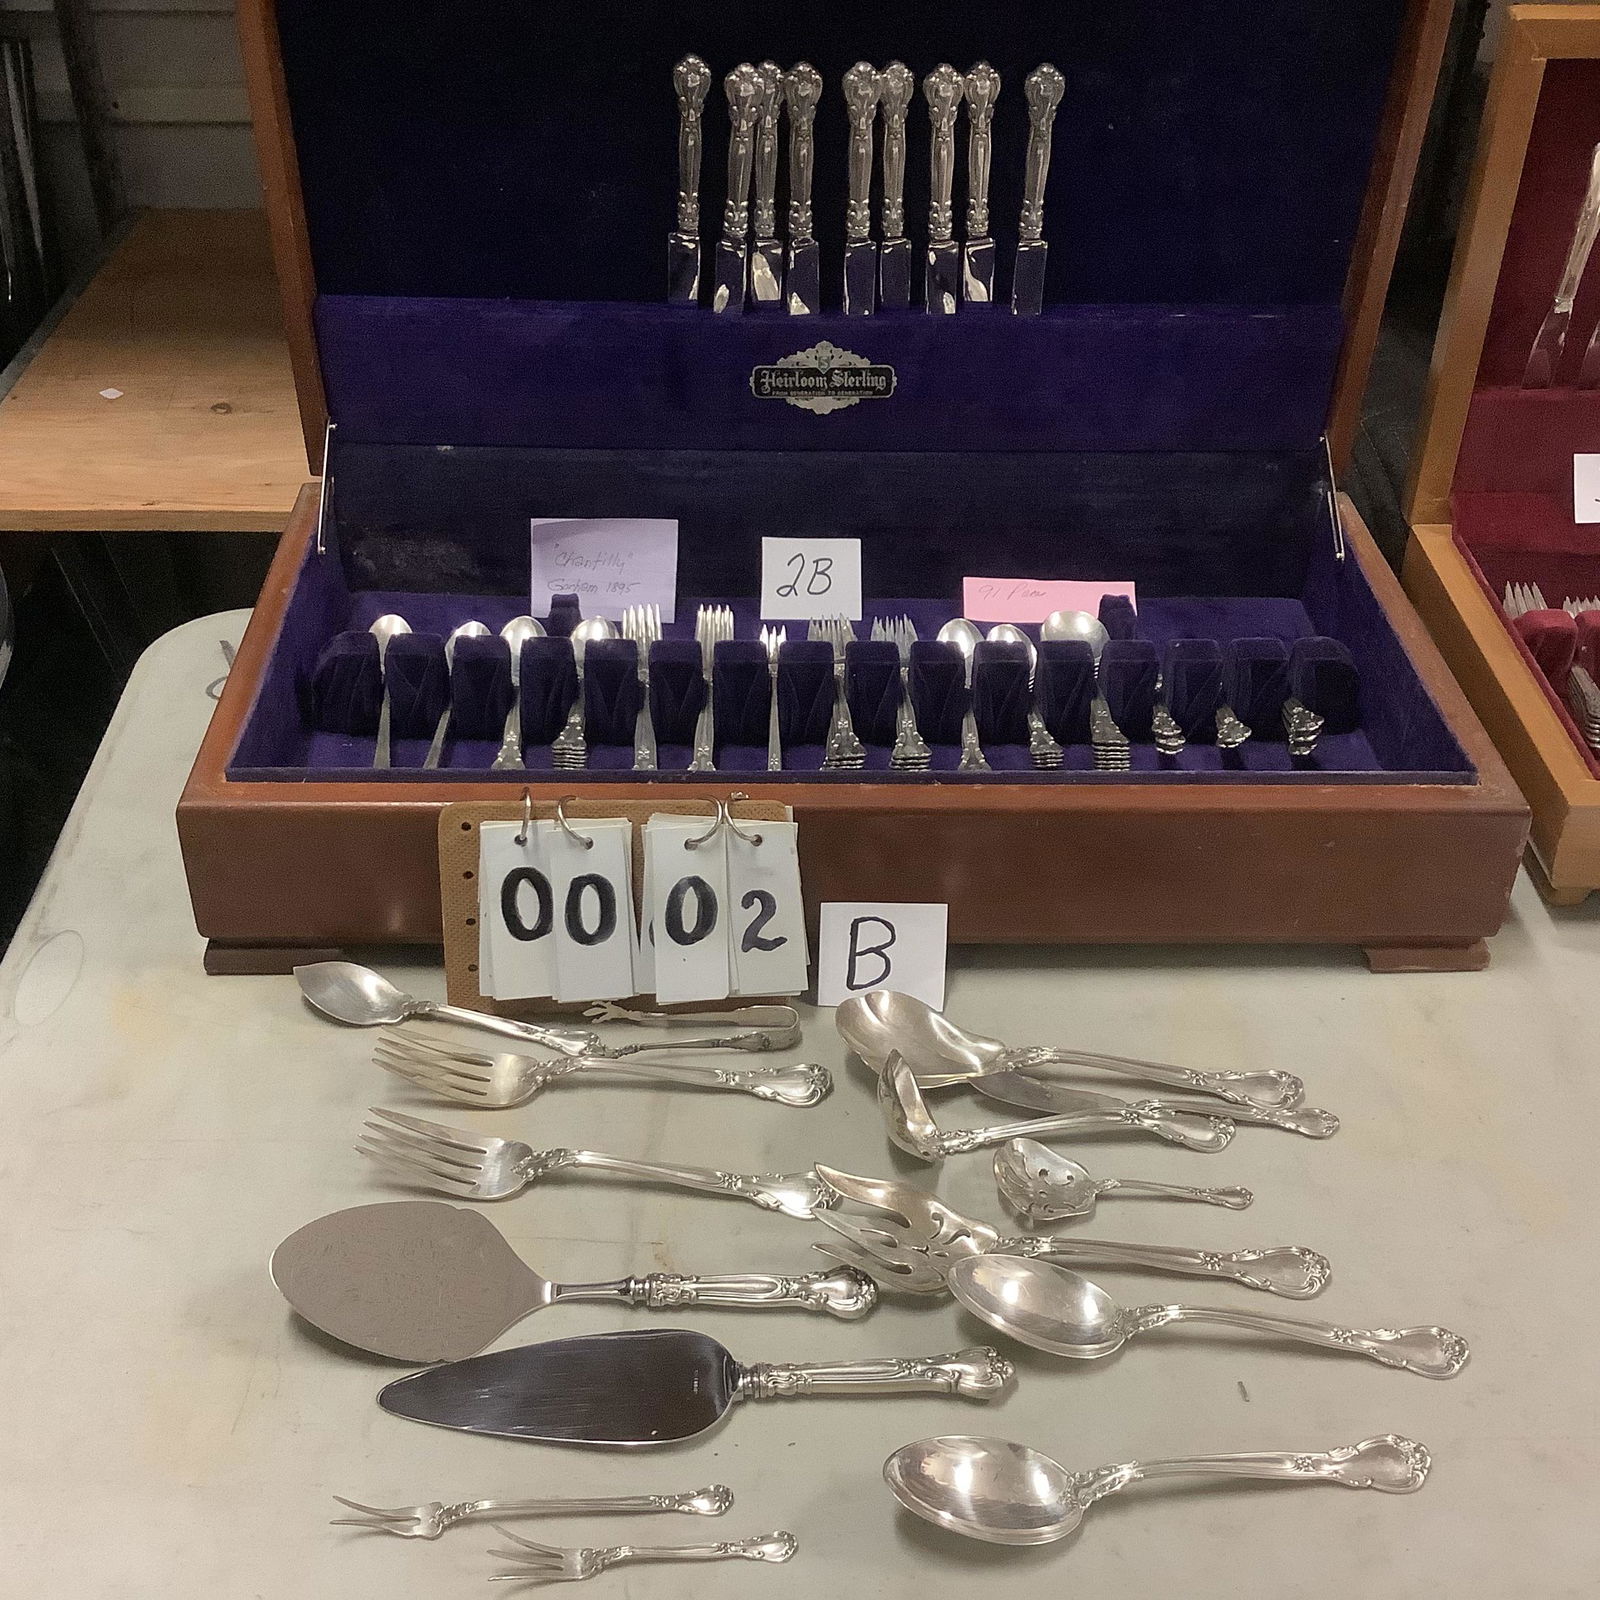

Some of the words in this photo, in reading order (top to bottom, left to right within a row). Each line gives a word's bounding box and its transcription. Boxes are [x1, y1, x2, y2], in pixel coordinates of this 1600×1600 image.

[760, 369, 828, 394] Heirloom
[829, 368, 887, 391] Sterling
[605, 581, 641, 595] 1895
[775, 552, 834, 598] 2B
[846, 915, 897, 991] B
